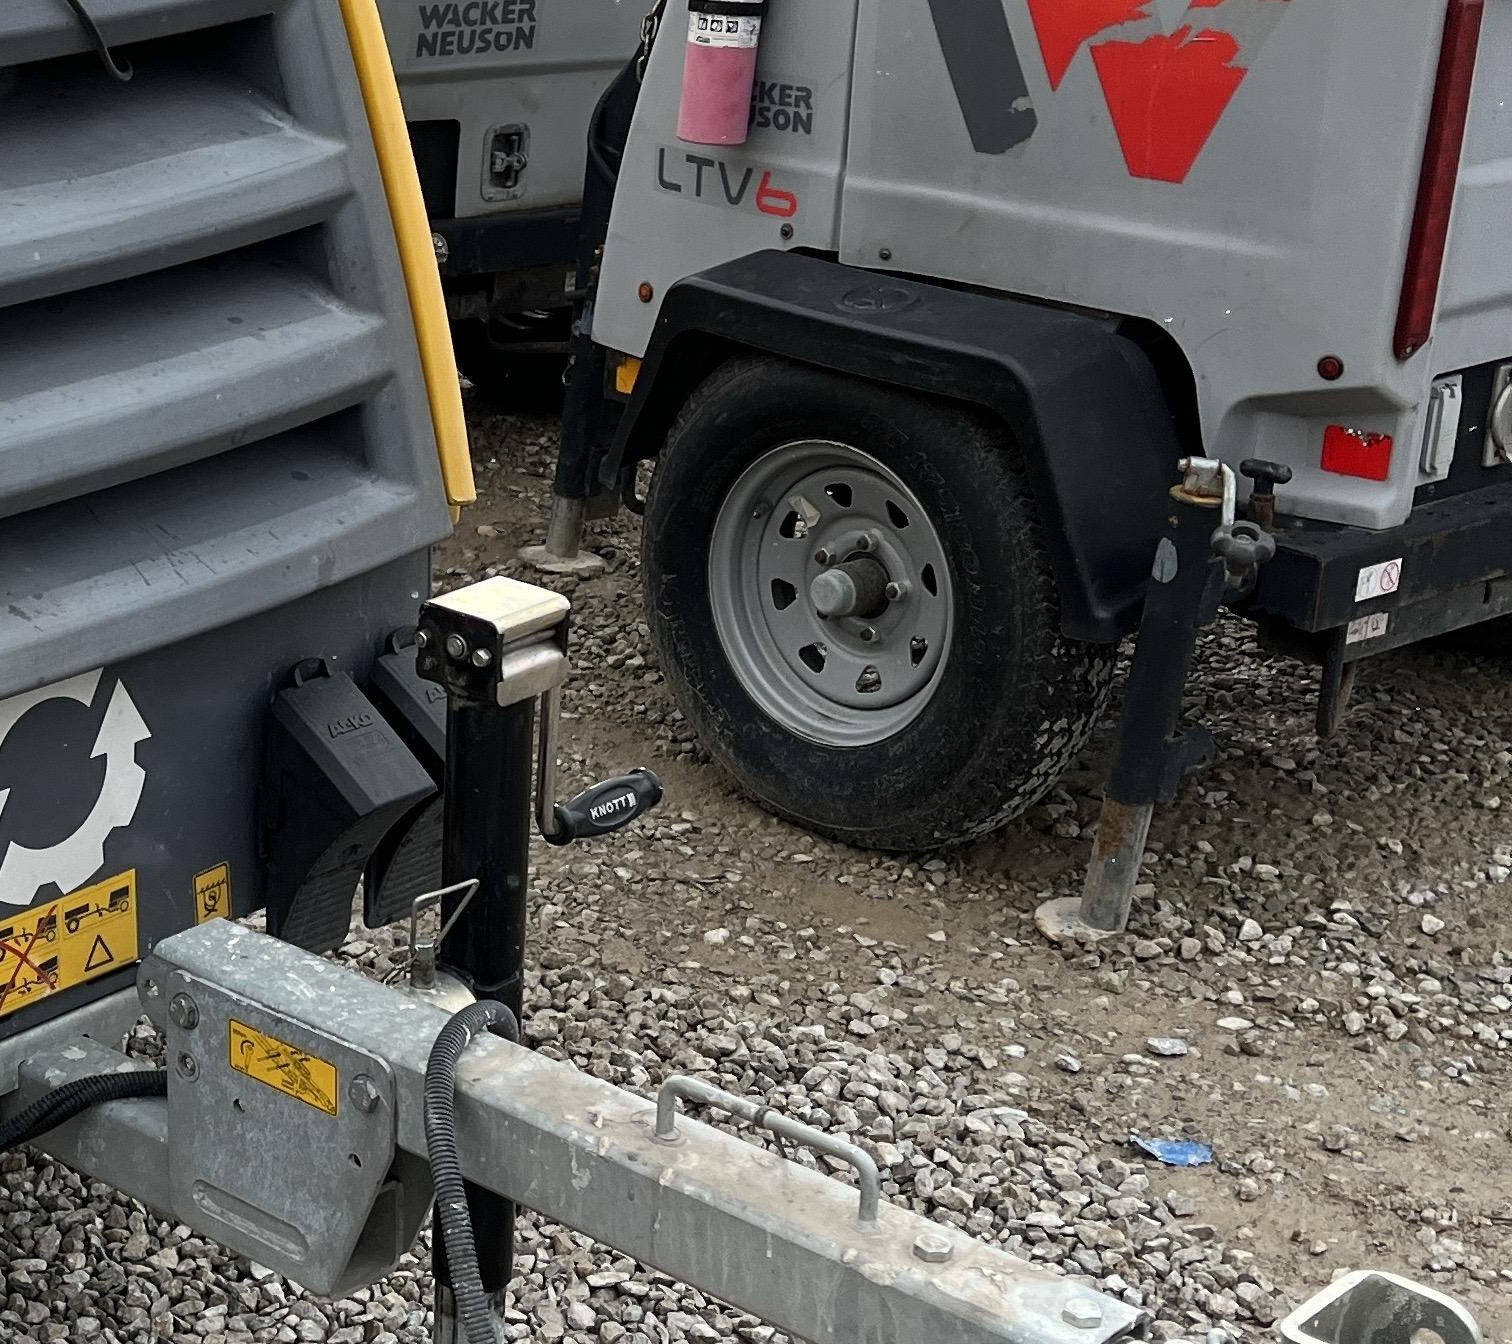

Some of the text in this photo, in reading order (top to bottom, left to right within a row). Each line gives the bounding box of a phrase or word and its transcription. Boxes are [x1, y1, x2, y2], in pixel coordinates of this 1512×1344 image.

[416, 25, 536, 58] NEUSON
[657, 147, 799, 218] LTV6
[589, 795, 627, 820] KNOTT
